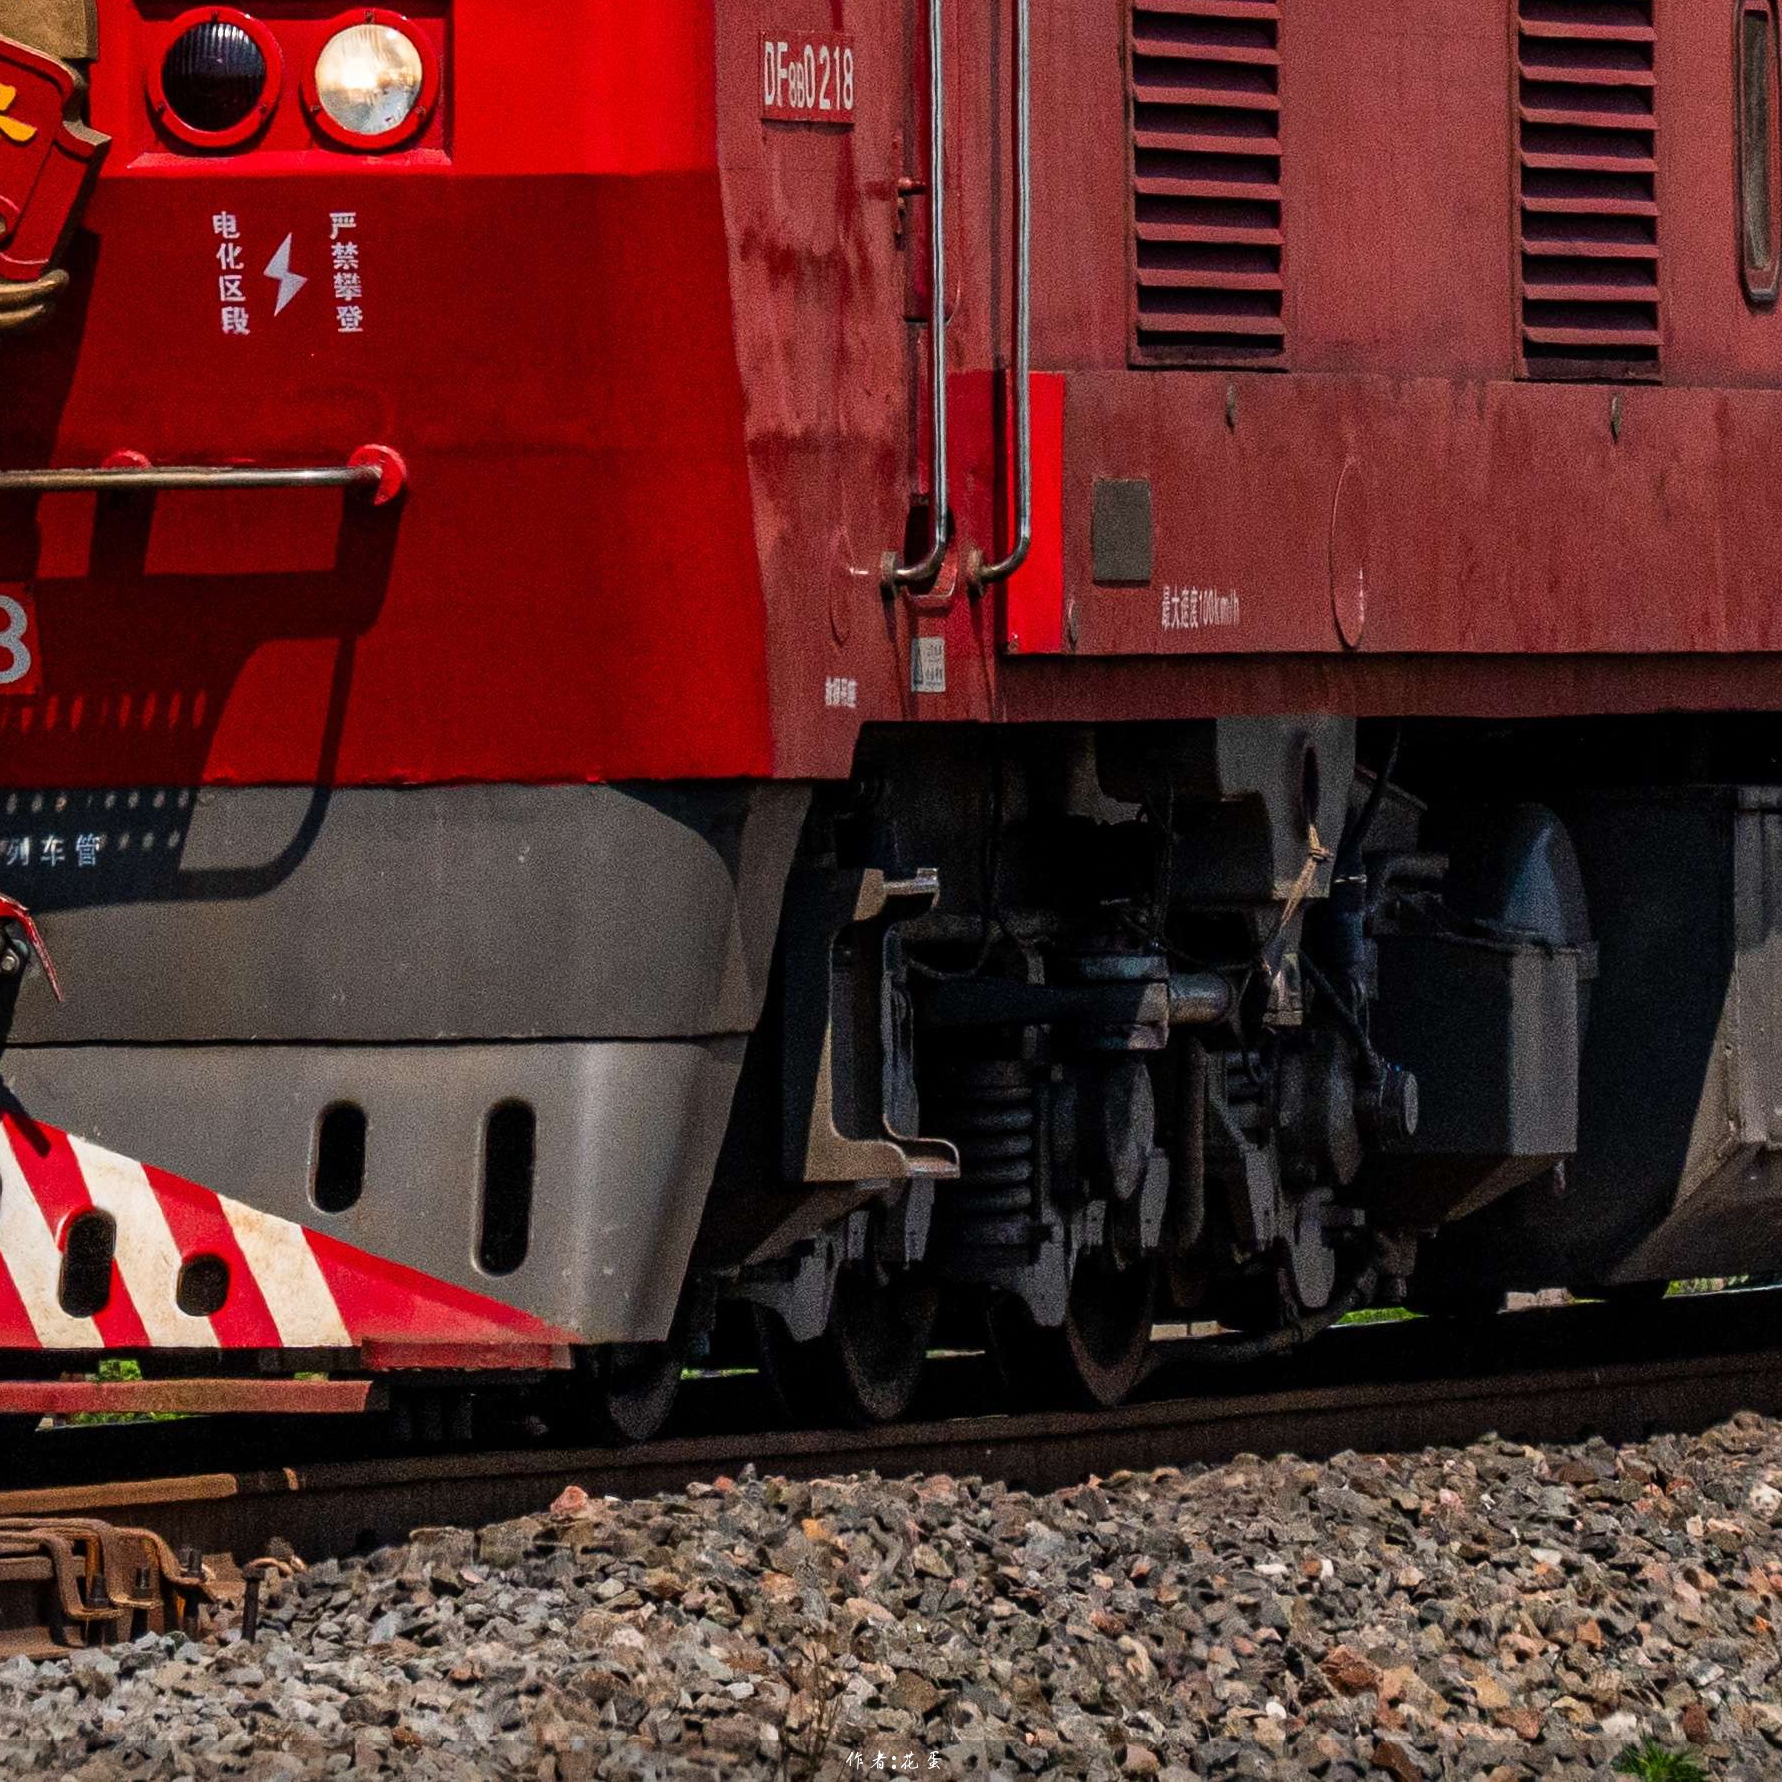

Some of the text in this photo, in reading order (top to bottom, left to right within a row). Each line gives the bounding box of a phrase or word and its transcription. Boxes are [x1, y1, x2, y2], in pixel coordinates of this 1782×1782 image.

[764, 41, 854, 110] DF8B0218
[211, 210, 251, 335] 电化区段
[329, 211, 364, 333] 严禁攀登
